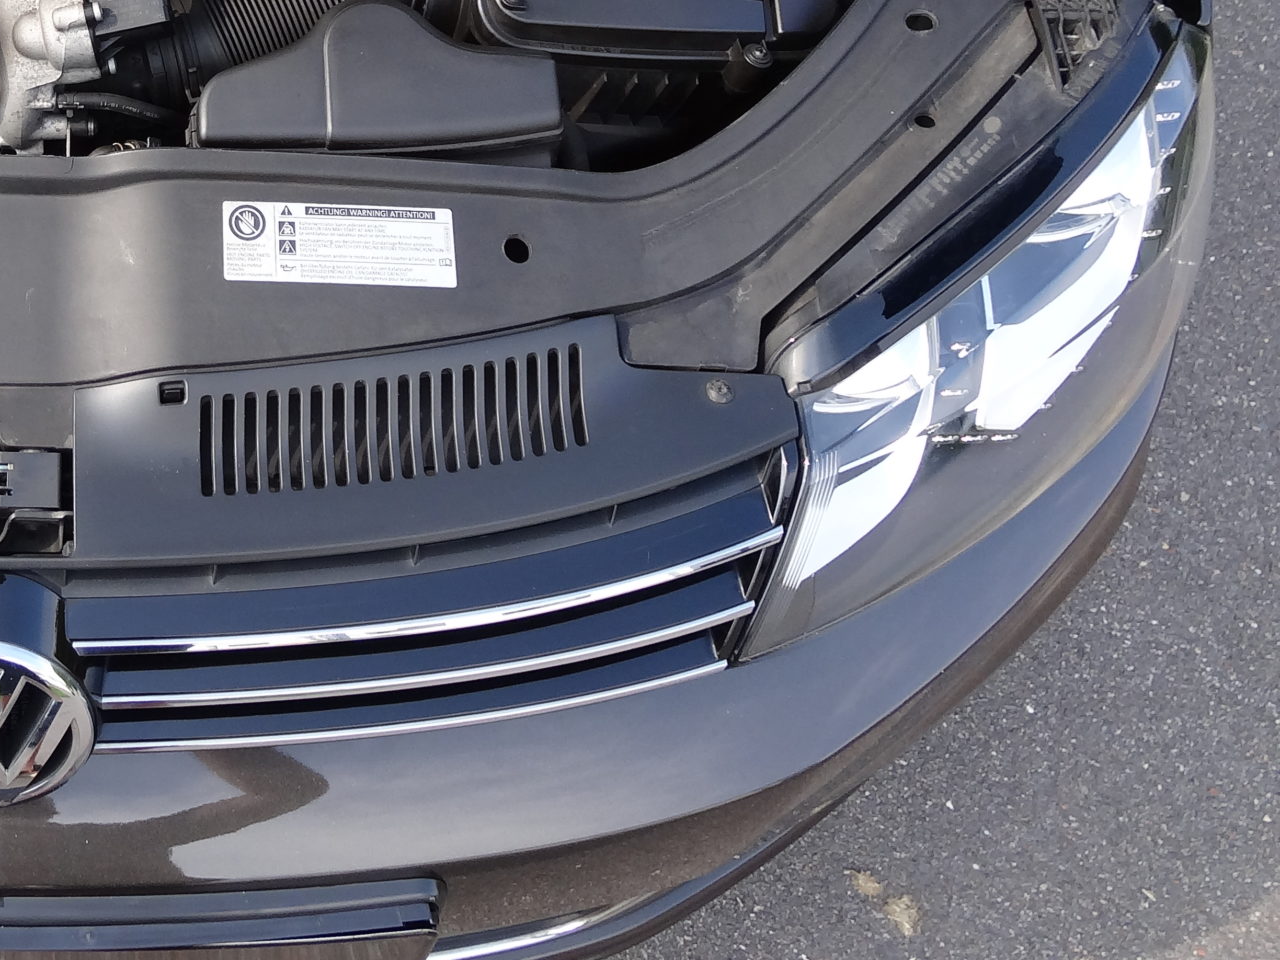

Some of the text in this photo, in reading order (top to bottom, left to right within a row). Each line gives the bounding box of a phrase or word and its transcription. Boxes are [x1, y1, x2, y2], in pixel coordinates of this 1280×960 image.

[308, 207, 433, 220] ACHTUNG! WARNING! ATTENTION!
